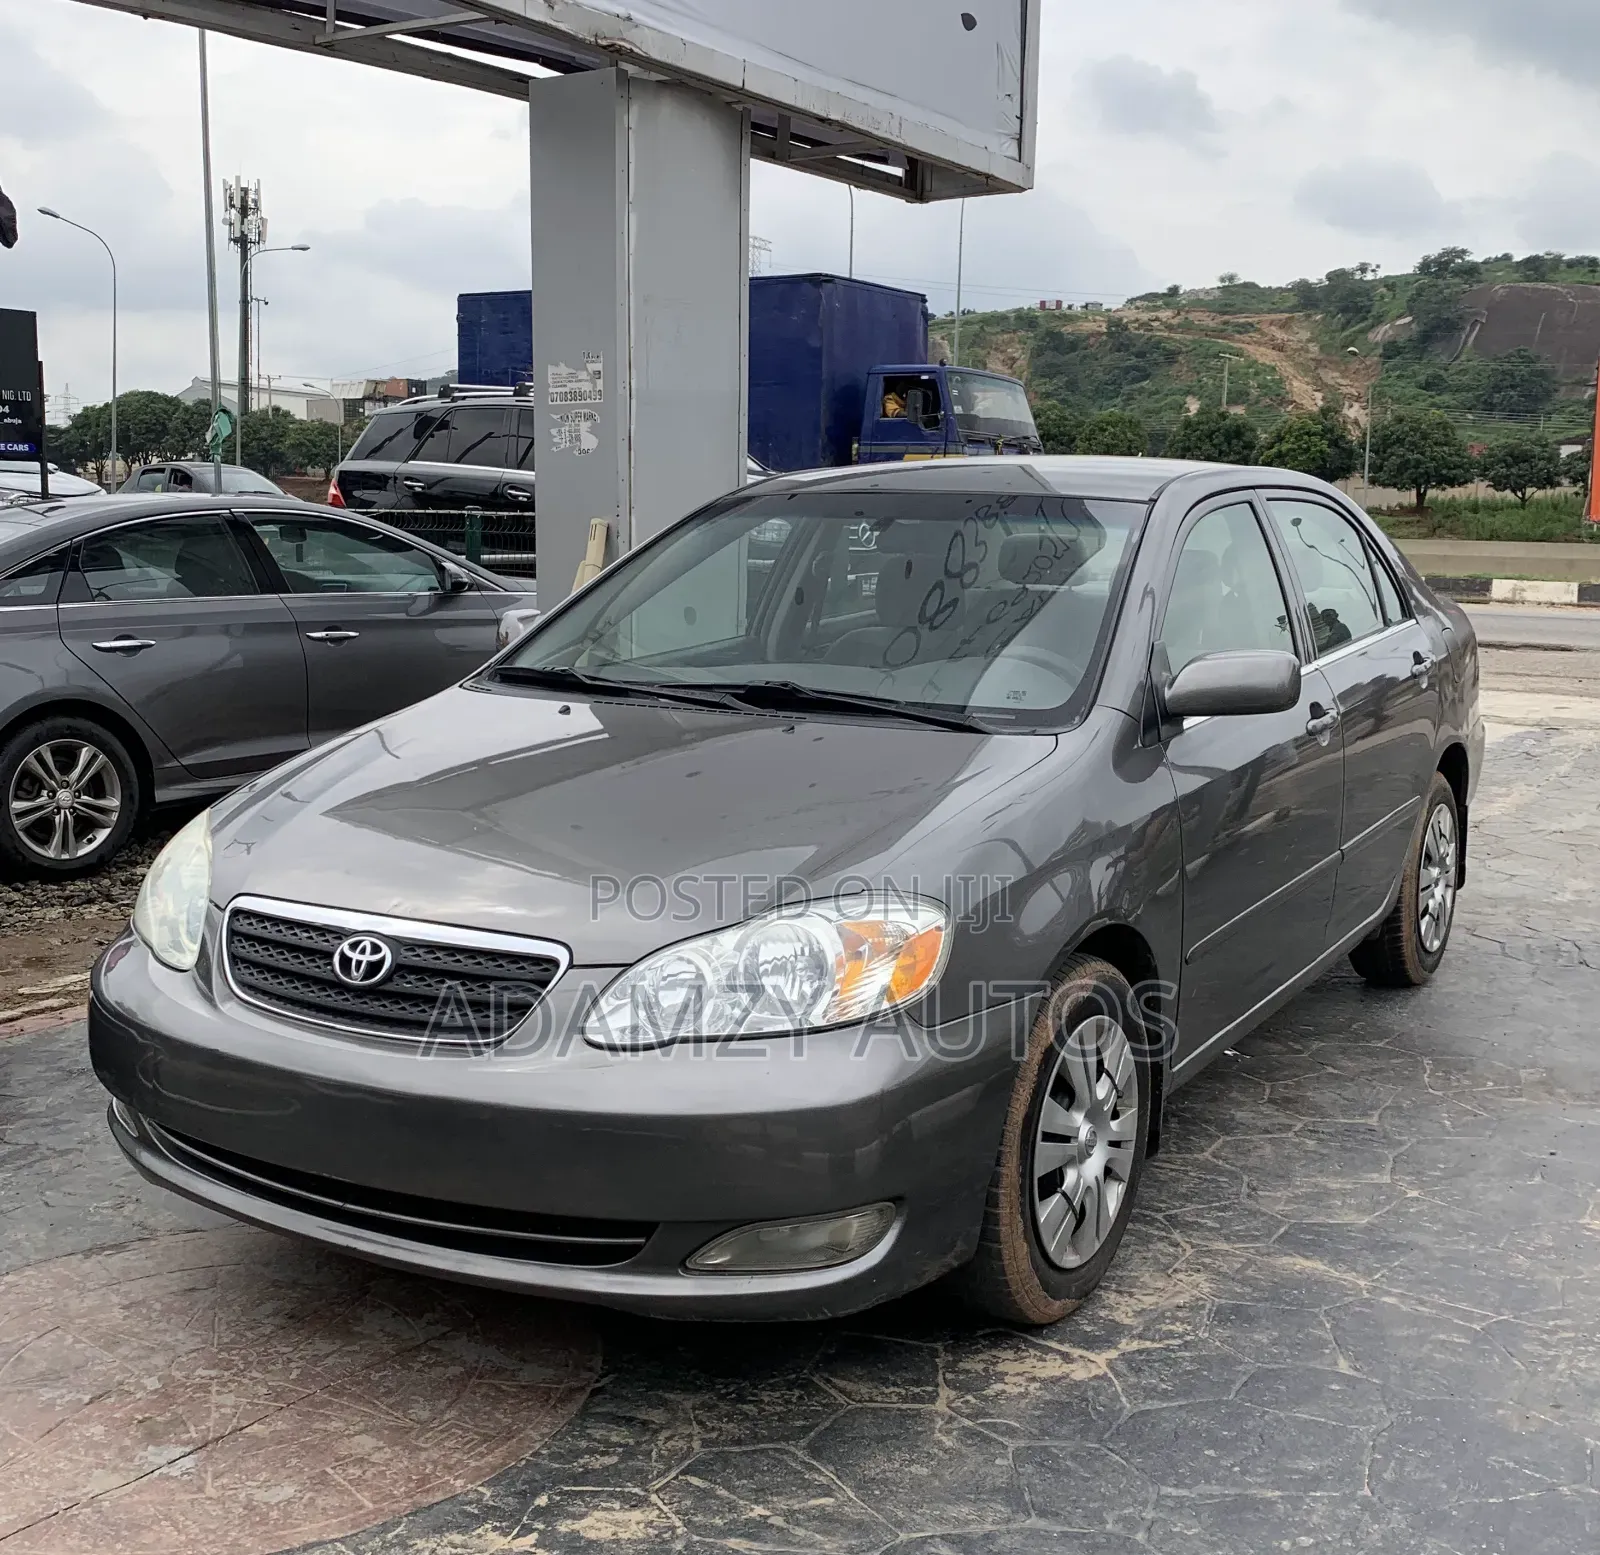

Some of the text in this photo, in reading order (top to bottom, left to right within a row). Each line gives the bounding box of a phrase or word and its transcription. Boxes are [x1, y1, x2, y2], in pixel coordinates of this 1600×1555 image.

[2, 390, 31, 401] NIG. LTD
[7, 443, 29, 451] CARS
